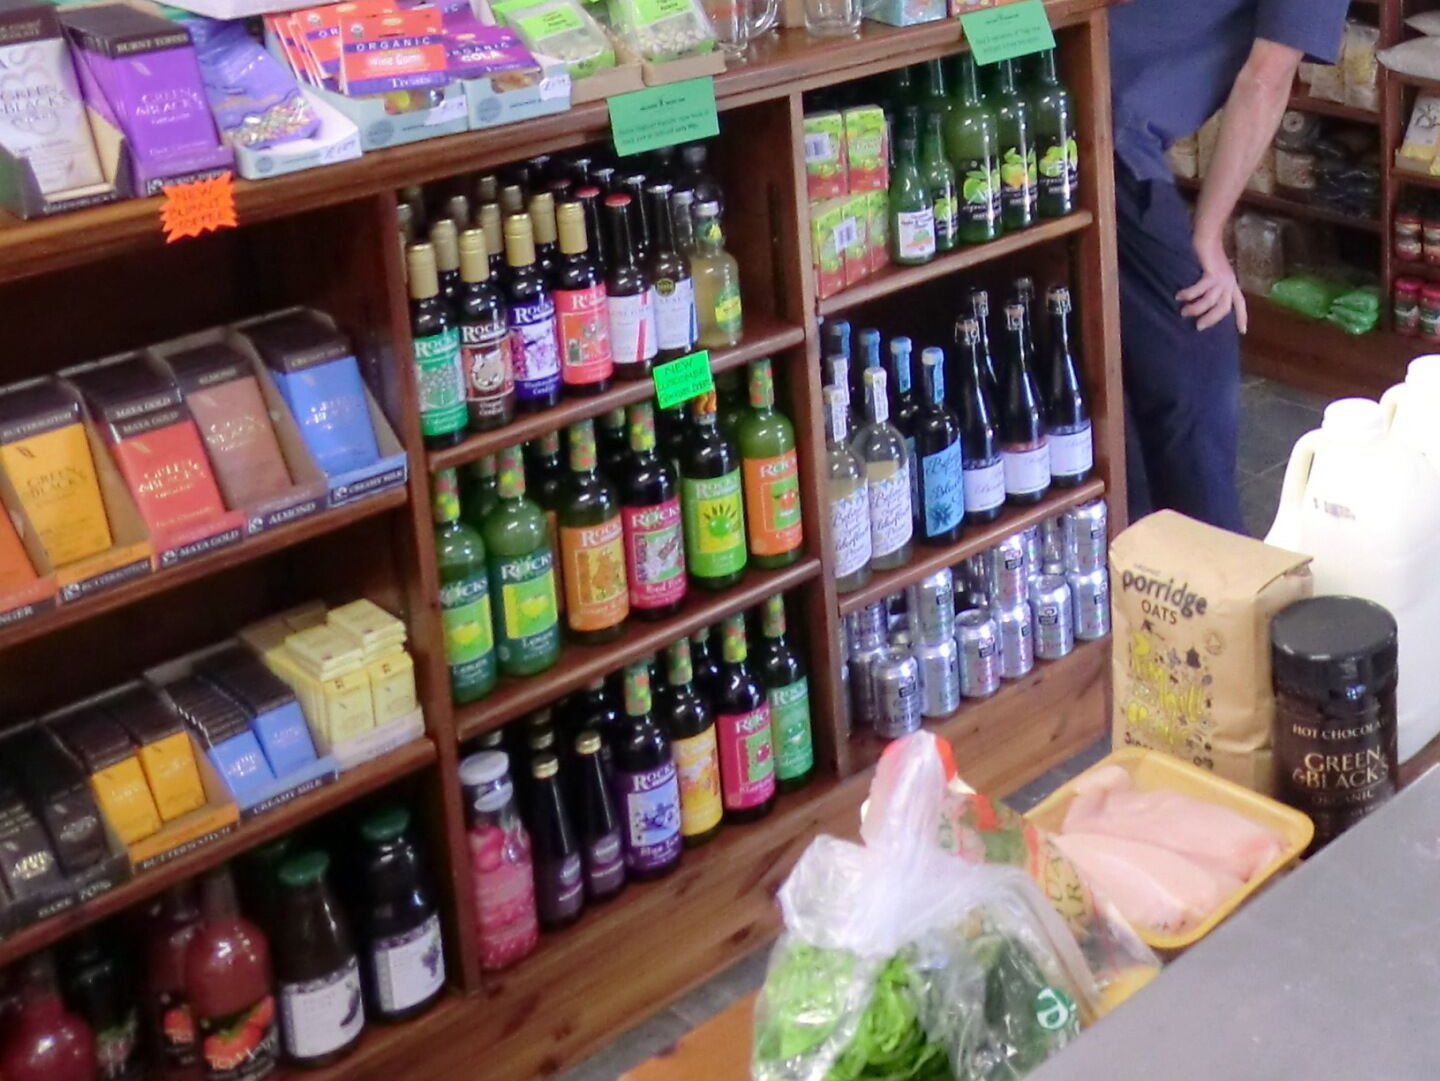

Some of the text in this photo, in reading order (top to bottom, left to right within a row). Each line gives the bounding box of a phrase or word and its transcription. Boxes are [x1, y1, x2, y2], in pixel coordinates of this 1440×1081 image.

[355, 36, 432, 53] ORGANIC
[210, 529, 240, 546] GOLD
[1121, 568, 1208, 618] porridge
[1141, 598, 1177, 625] OATS
[1292, 724, 1318, 738] HOT
[1304, 745, 1382, 774] GREEN
